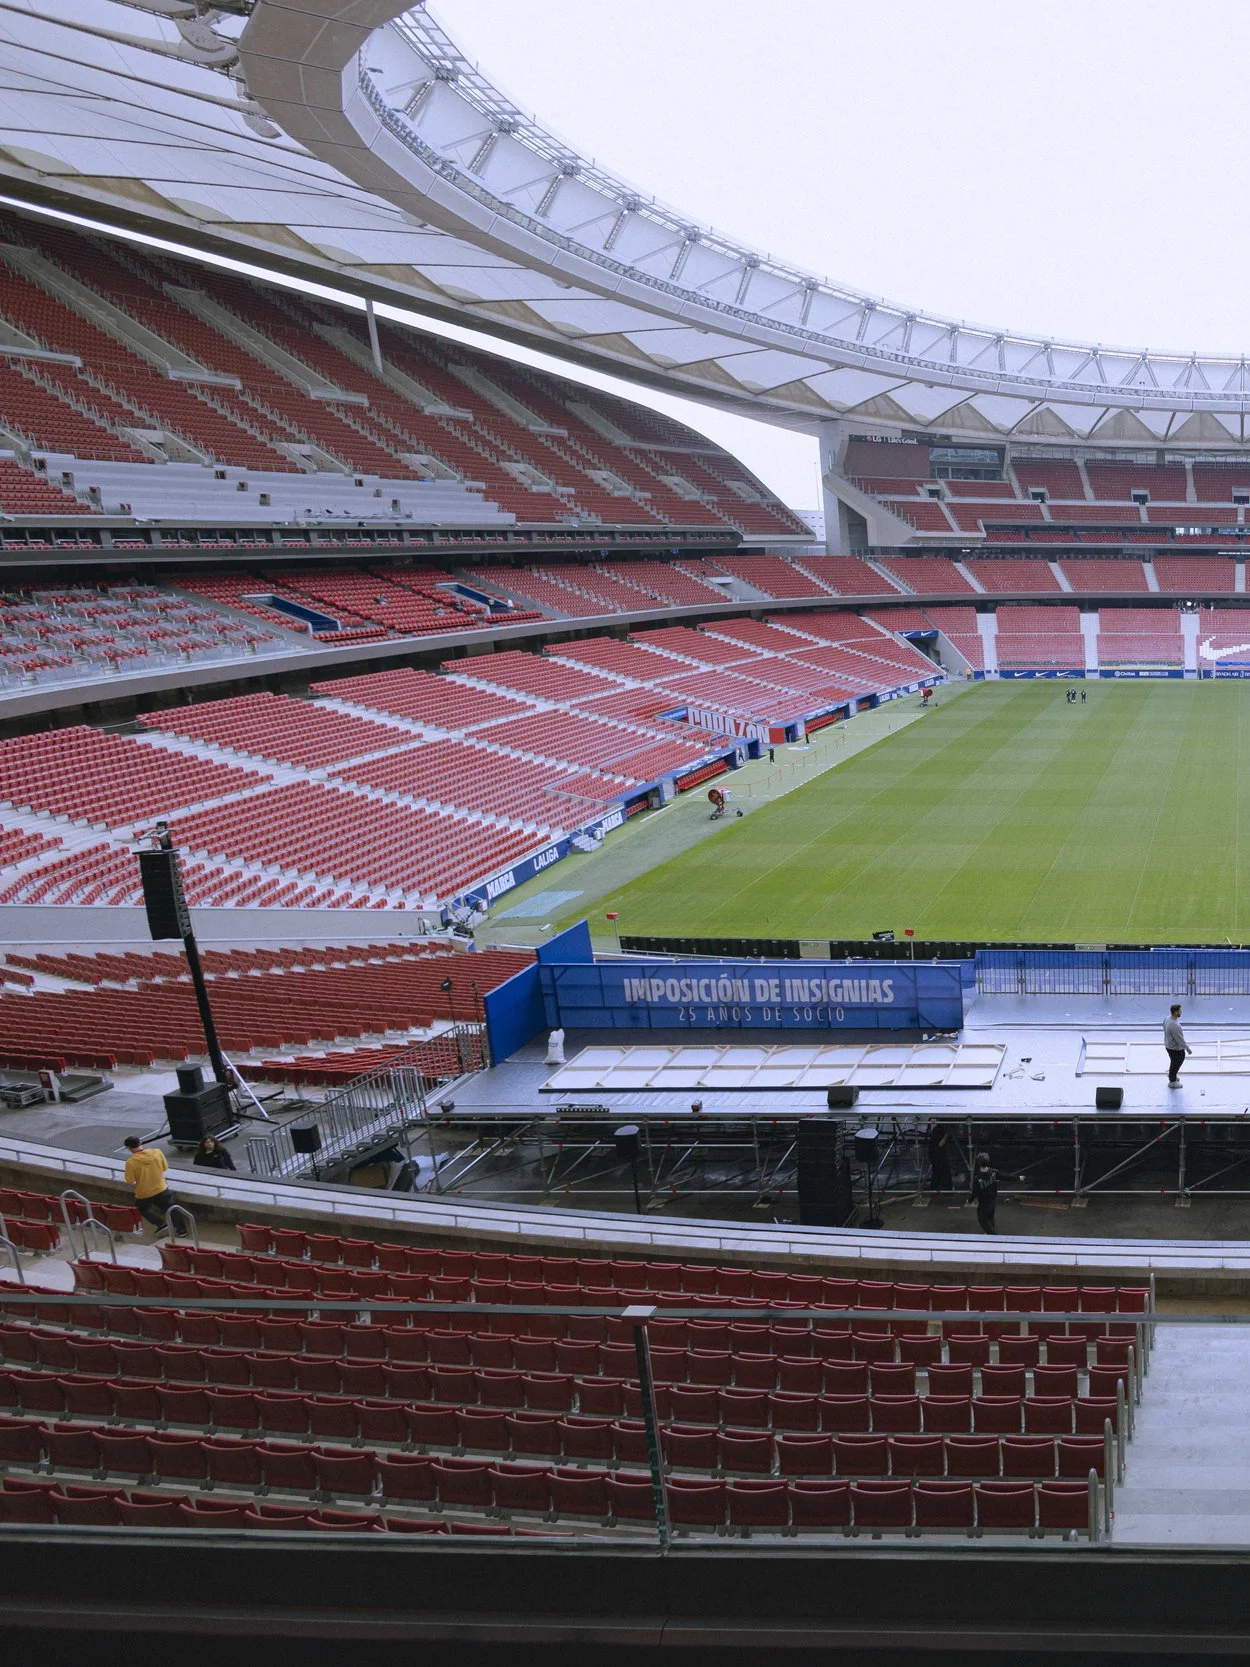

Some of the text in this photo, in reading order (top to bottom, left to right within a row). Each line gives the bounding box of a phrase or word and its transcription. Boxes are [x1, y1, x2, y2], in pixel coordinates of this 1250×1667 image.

[872, 435, 882, 443] LG
[602, 811, 623, 832] MARCA
[534, 847, 559, 871] LALIGA
[486, 871, 516, 900] MARCA
[623, 973, 894, 1003] IMPOSICIÓN DE INSIGNIAS
[678, 1004, 845, 1022] 25 AÑOS DE SOCIO
